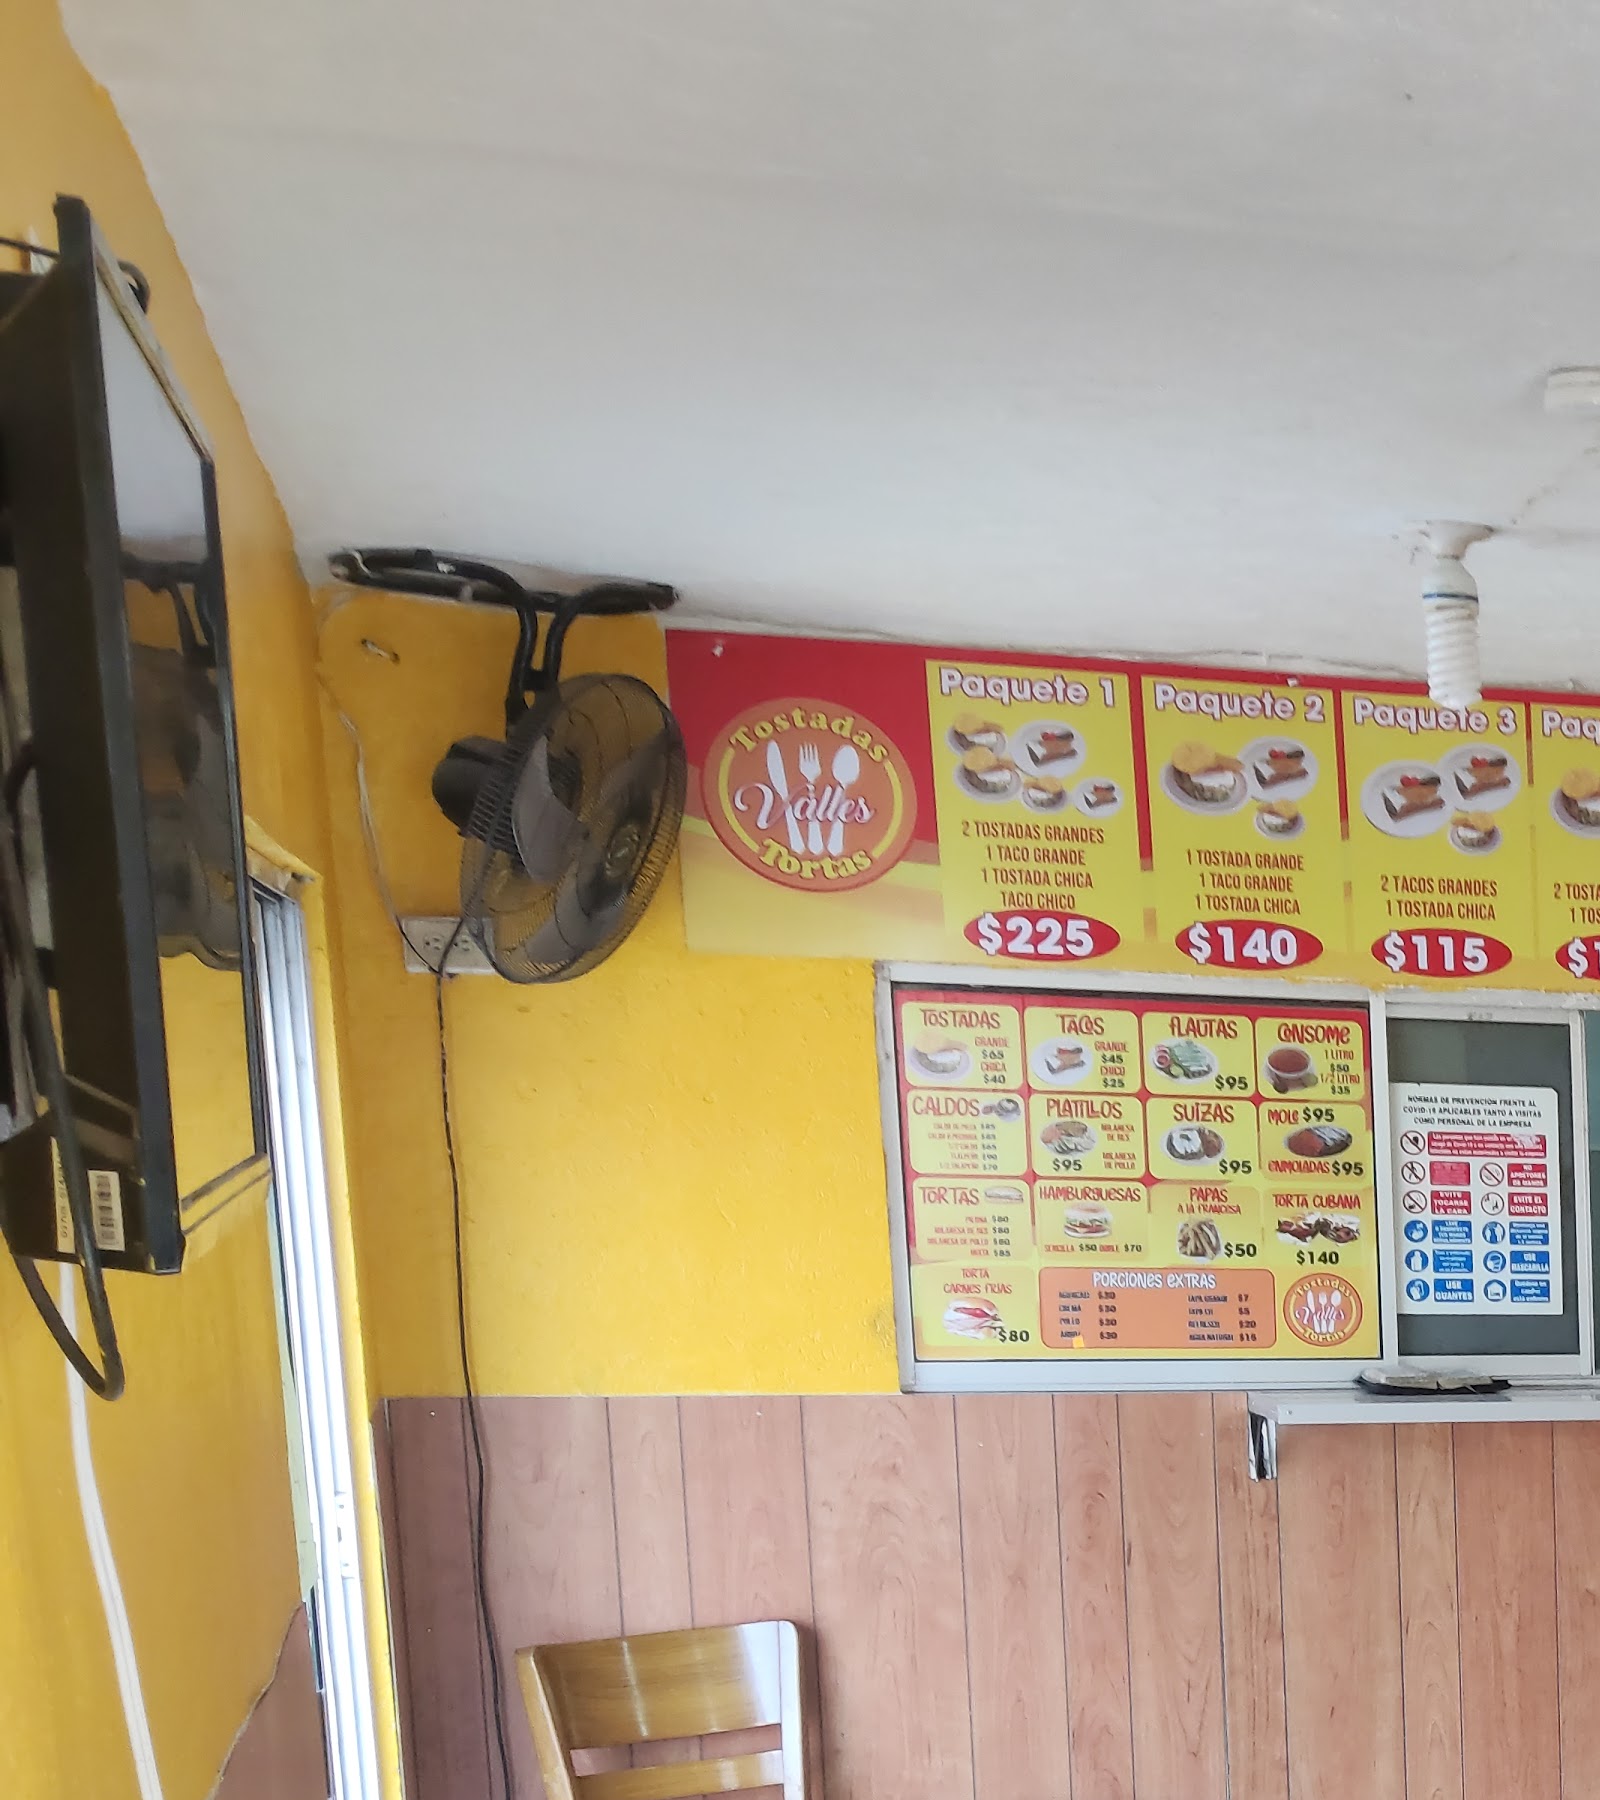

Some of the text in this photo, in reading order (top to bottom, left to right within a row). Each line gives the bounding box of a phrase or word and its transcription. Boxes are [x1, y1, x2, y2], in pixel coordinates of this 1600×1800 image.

[939, 666, 1115, 708] Paquete 1
[1154, 681, 1326, 723] Paquete 2
[1353, 695, 1517, 734] Paquete 3
[729, 706, 889, 763] Tostadas
[734, 781, 877, 830] Valles
[962, 821, 1105, 844] 2 TOSTADAS GRANDES
[758, 837, 873, 880] Tortas
[996, 847, 1030, 863] TACO
[1034, 849, 1086, 866] GRANDE
[1196, 850, 1252, 868] TOSTADA
[1255, 853, 1304, 871] GRANDE
[992, 868, 1051, 886] TOSTADA
[1055, 871, 1094, 889] CHICA
[1199, 872, 1293, 893] 1 TACO GRANDE
[1381, 875, 1498, 897] 2 TACOS GRANDES
[1000, 891, 1076, 910] TACO CHICO
[1553, 883, 1561, 899] 2
[1195, 894, 1300, 915] 1 TOSTADA CHICA
[1386, 900, 1496, 921] 1 TOSTADA CHICA
[977, 912, 1094, 957] $225
[1188, 921, 1298, 965] $140
[1384, 929, 1489, 973] $115
[920, 1008, 1000, 1030] TOSTADAS
[1056, 1014, 1105, 1036] TACOS
[1169, 1016, 1238, 1039] FLAUTAS
[1101, 1054, 1124, 1064] $45
[984, 1074, 1006, 1084] $40
[1102, 1078, 1125, 1088] $25
[1215, 1074, 1249, 1091] $95
[912, 1097, 981, 1117] CALDOS
[1046, 1098, 1123, 1119] PLATILLOS
[1173, 1103, 1235, 1124] SUIZAS
[1267, 1106, 1335, 1126] MOLE $95
[1053, 1158, 1082, 1172] $95
[1219, 1158, 1252, 1175] $95
[1332, 1160, 1364, 1177] $95
[918, 1186, 980, 1206] TORTAS
[1039, 1185, 1141, 1202] HAMBURGUESAS
[1189, 1187, 1228, 1203] PAPAS
[1272, 1194, 1361, 1209] TORTA CUBANA
[1510, 1205, 1547, 1214] CONTACTO
[1079, 1243, 1097, 1252] $50
[1124, 1243, 1142, 1252] $70
[1224, 1242, 1257, 1258] $50
[1296, 1250, 1340, 1265] $140
[961, 1268, 990, 1279] TORTA
[1092, 1272, 1217, 1290] PORCIONES EXTRAS
[943, 1284, 1012, 1294] CARNES FRIAS
[1294, 1277, 1351, 1297] Tostadas
[998, 1330, 1030, 1343] $80
